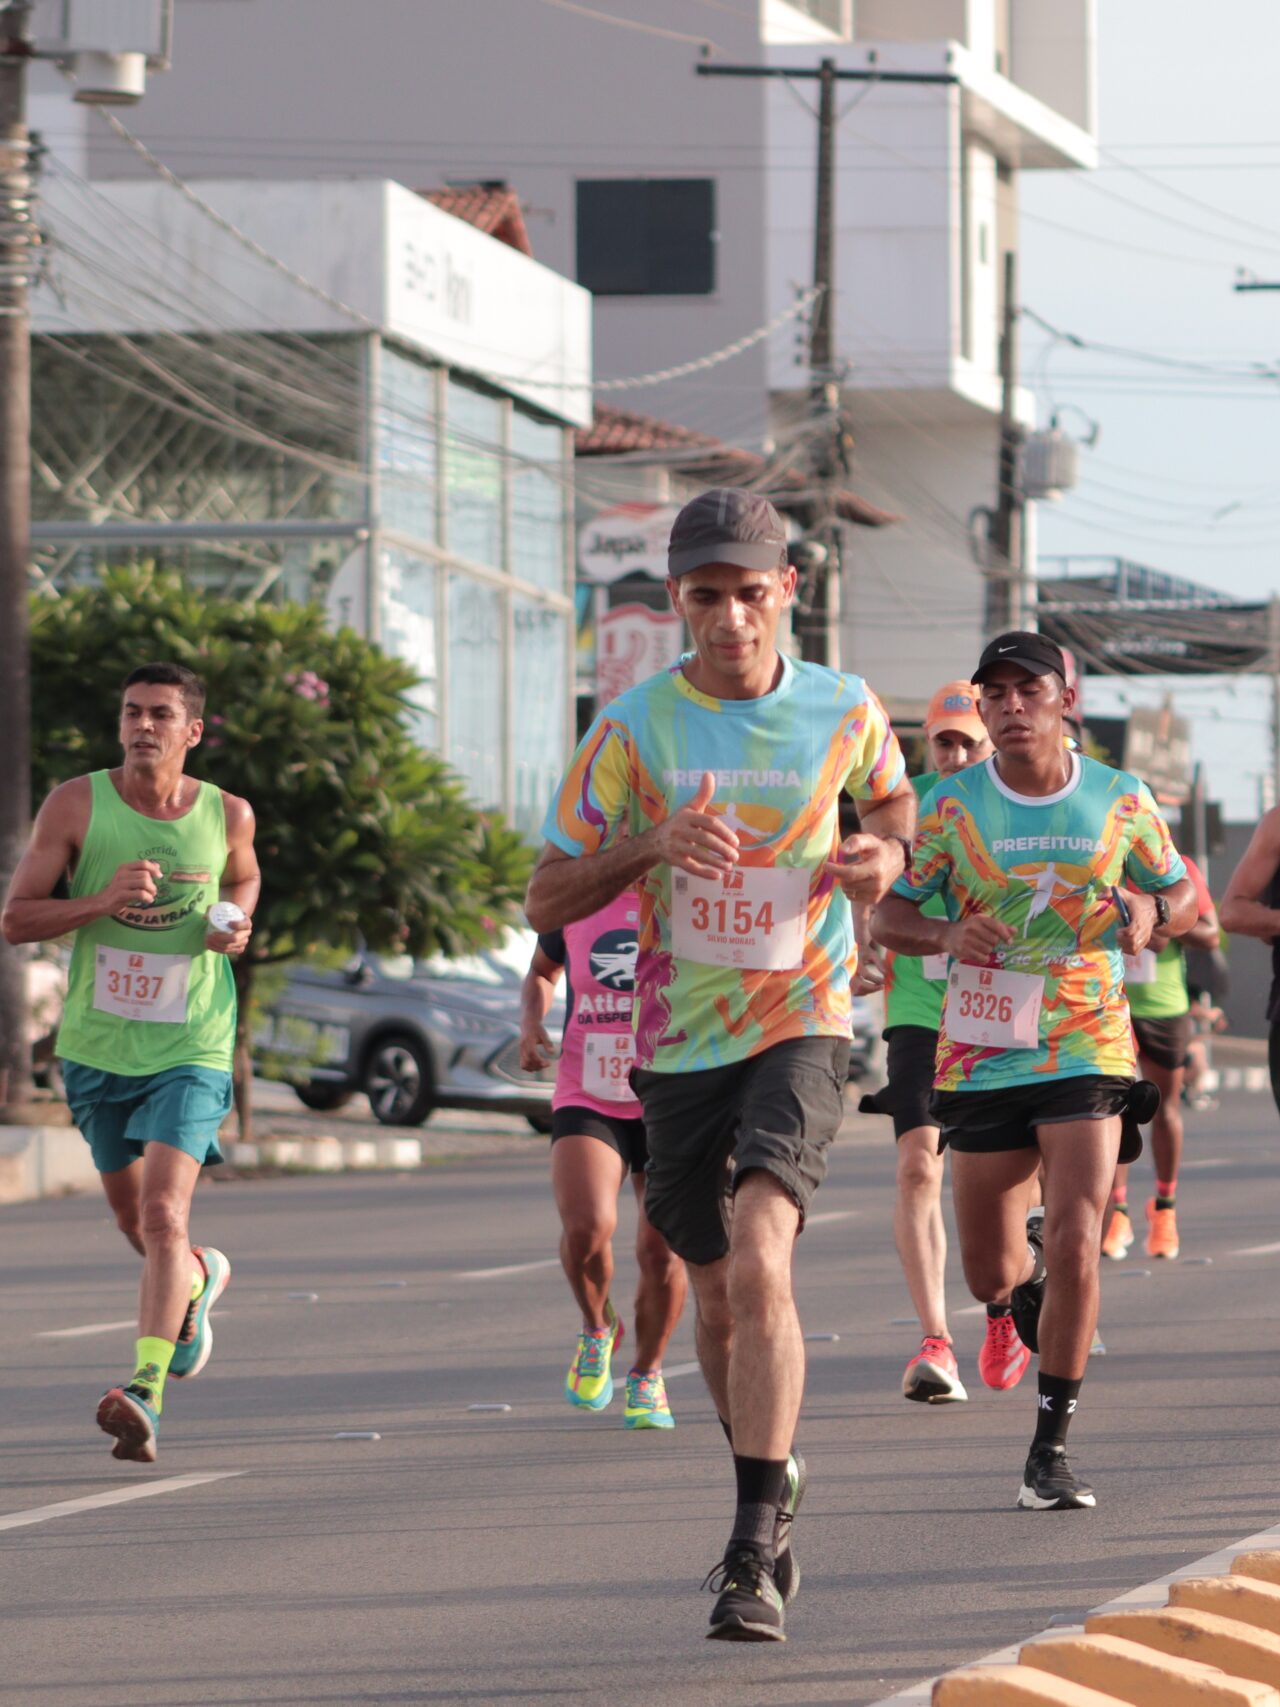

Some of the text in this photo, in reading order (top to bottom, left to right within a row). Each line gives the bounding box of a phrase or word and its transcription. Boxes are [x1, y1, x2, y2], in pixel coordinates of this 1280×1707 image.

[943, 694, 972, 711] RIO
[992, 836, 1106, 854] PREFEITURA
[143, 890, 205, 925] LAVRADO
[691, 896, 775, 936] 3154
[1009, 953, 1032, 965] de
[107, 969, 165, 1000] 3137
[578, 992, 632, 1013] Atle
[959, 990, 1014, 1023] 3326
[577, 1013, 594, 1025] DA
